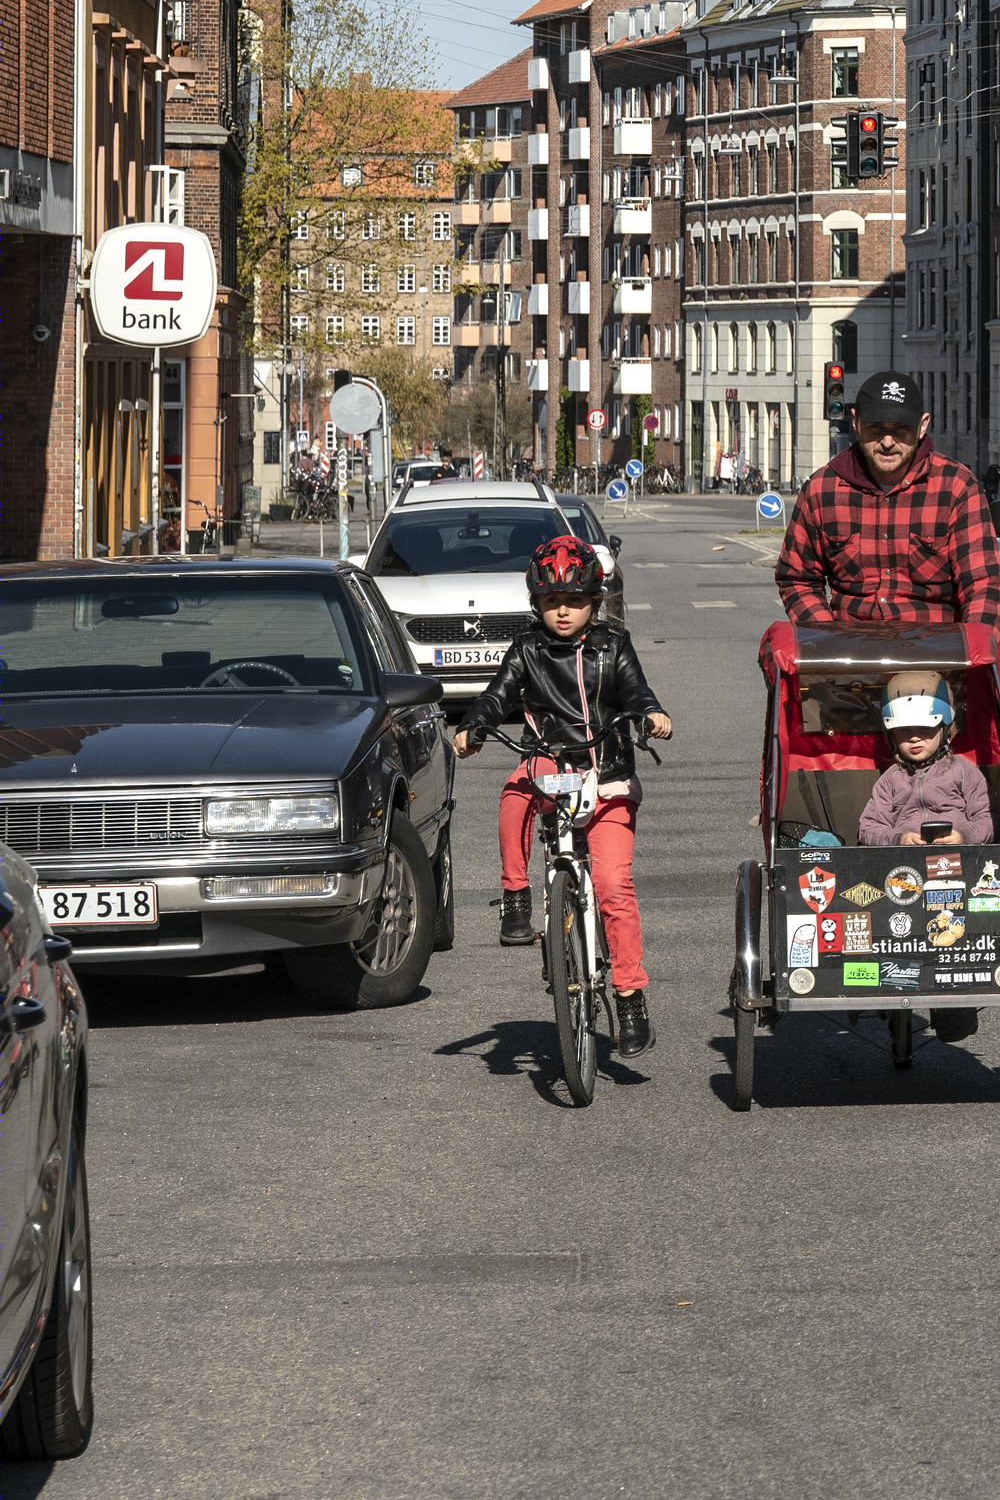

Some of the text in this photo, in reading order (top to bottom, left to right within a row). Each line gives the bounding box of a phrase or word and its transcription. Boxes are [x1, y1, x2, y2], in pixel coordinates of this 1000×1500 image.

[123, 306, 182, 330] bank
[165, 368, 178, 379] 44
[444, 651, 462, 664] BD
[465, 651, 481, 663] 53
[149, 831, 188, 840] BUICK
[926, 889, 963, 904] HSV?
[53, 890, 151, 919] 87 518
[939, 952, 996, 963] 32 54 87 48
[935, 971, 992, 983] THE BLUE VAN
